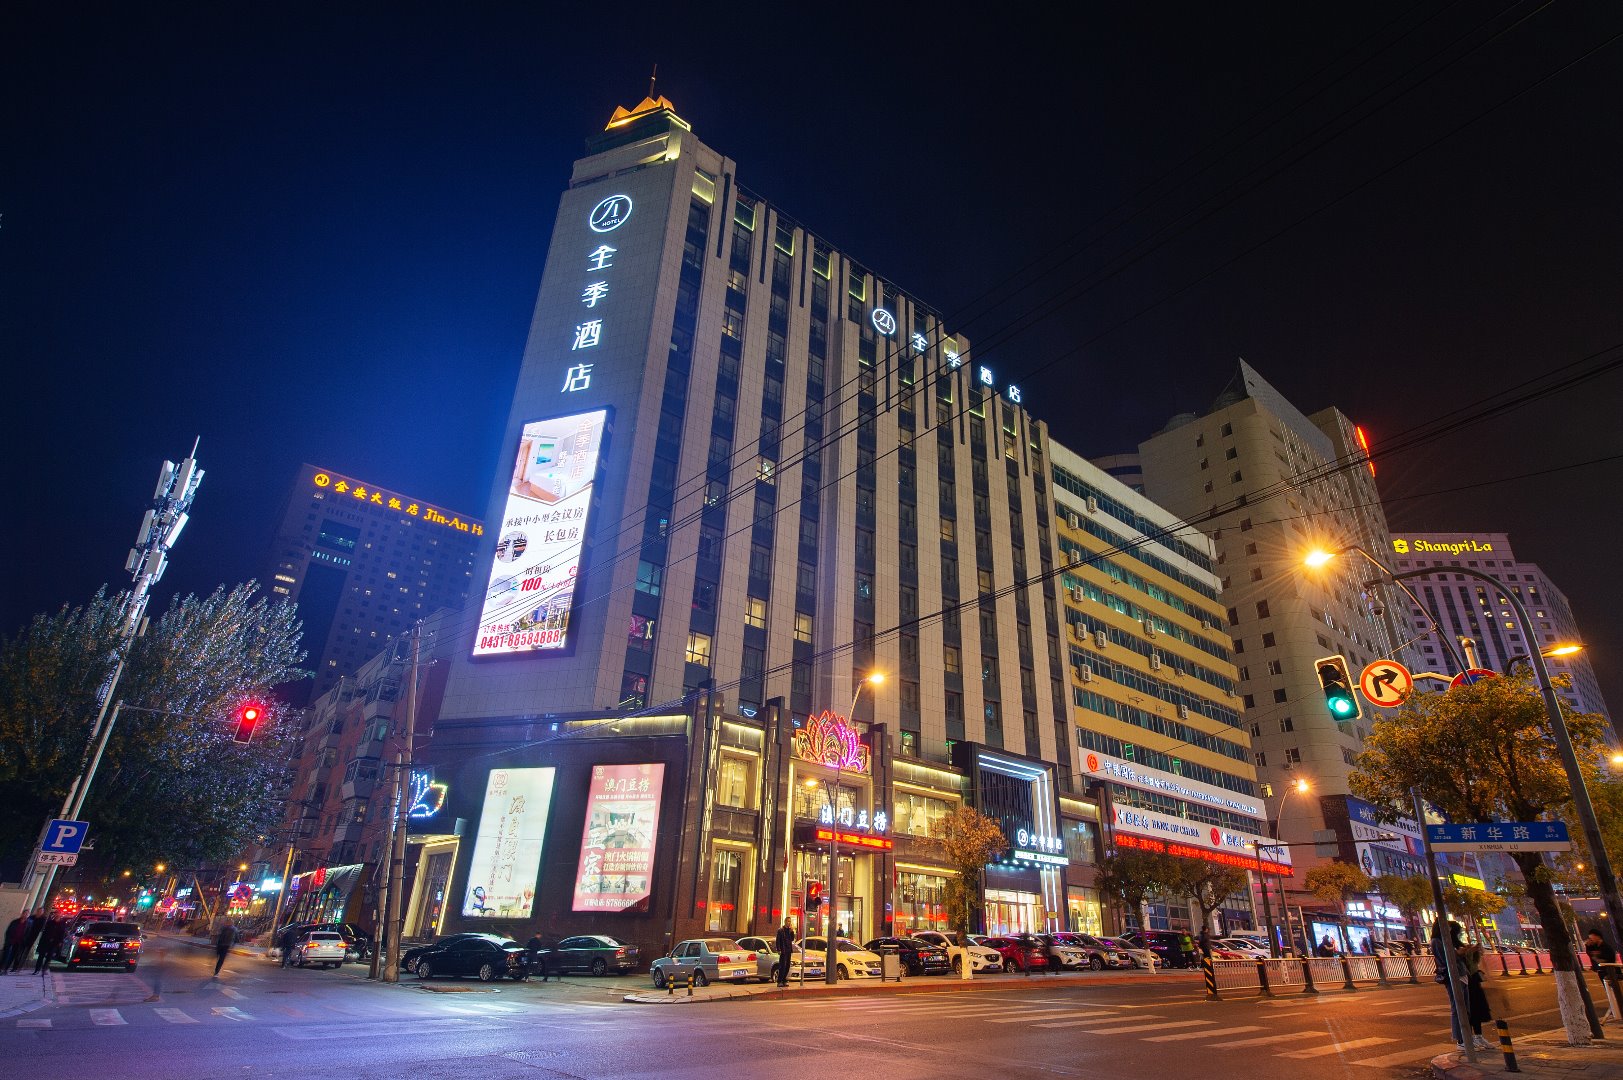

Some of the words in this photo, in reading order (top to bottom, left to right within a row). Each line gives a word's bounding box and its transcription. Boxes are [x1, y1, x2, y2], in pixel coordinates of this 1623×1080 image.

[561, 244, 618, 393] 全季酒店
[911, 332, 1021, 403] 全季酒店
[569, 418, 593, 482] 全季酒店
[423, 507, 469, 532] Jin-An
[544, 526, 579, 543] 长包房
[1414, 539, 1493, 555] Shangri-La
[521, 576, 542, 591] 100
[480, 629, 560, 649] 0431-88584888
[604, 777, 650, 792] 澳门豆捞
[820, 805, 887, 832] 澳门豆捞
[1117, 808, 1149, 831] 中国银行
[51, 825, 78, 848] P
[1437, 827, 1446, 835] 西
[1460, 825, 1531, 841] 新华路
[1030, 834, 1063, 850] 全季酒店
[40, 854, 76, 864] 停车入位
[583, 829, 607, 876] 正宗
